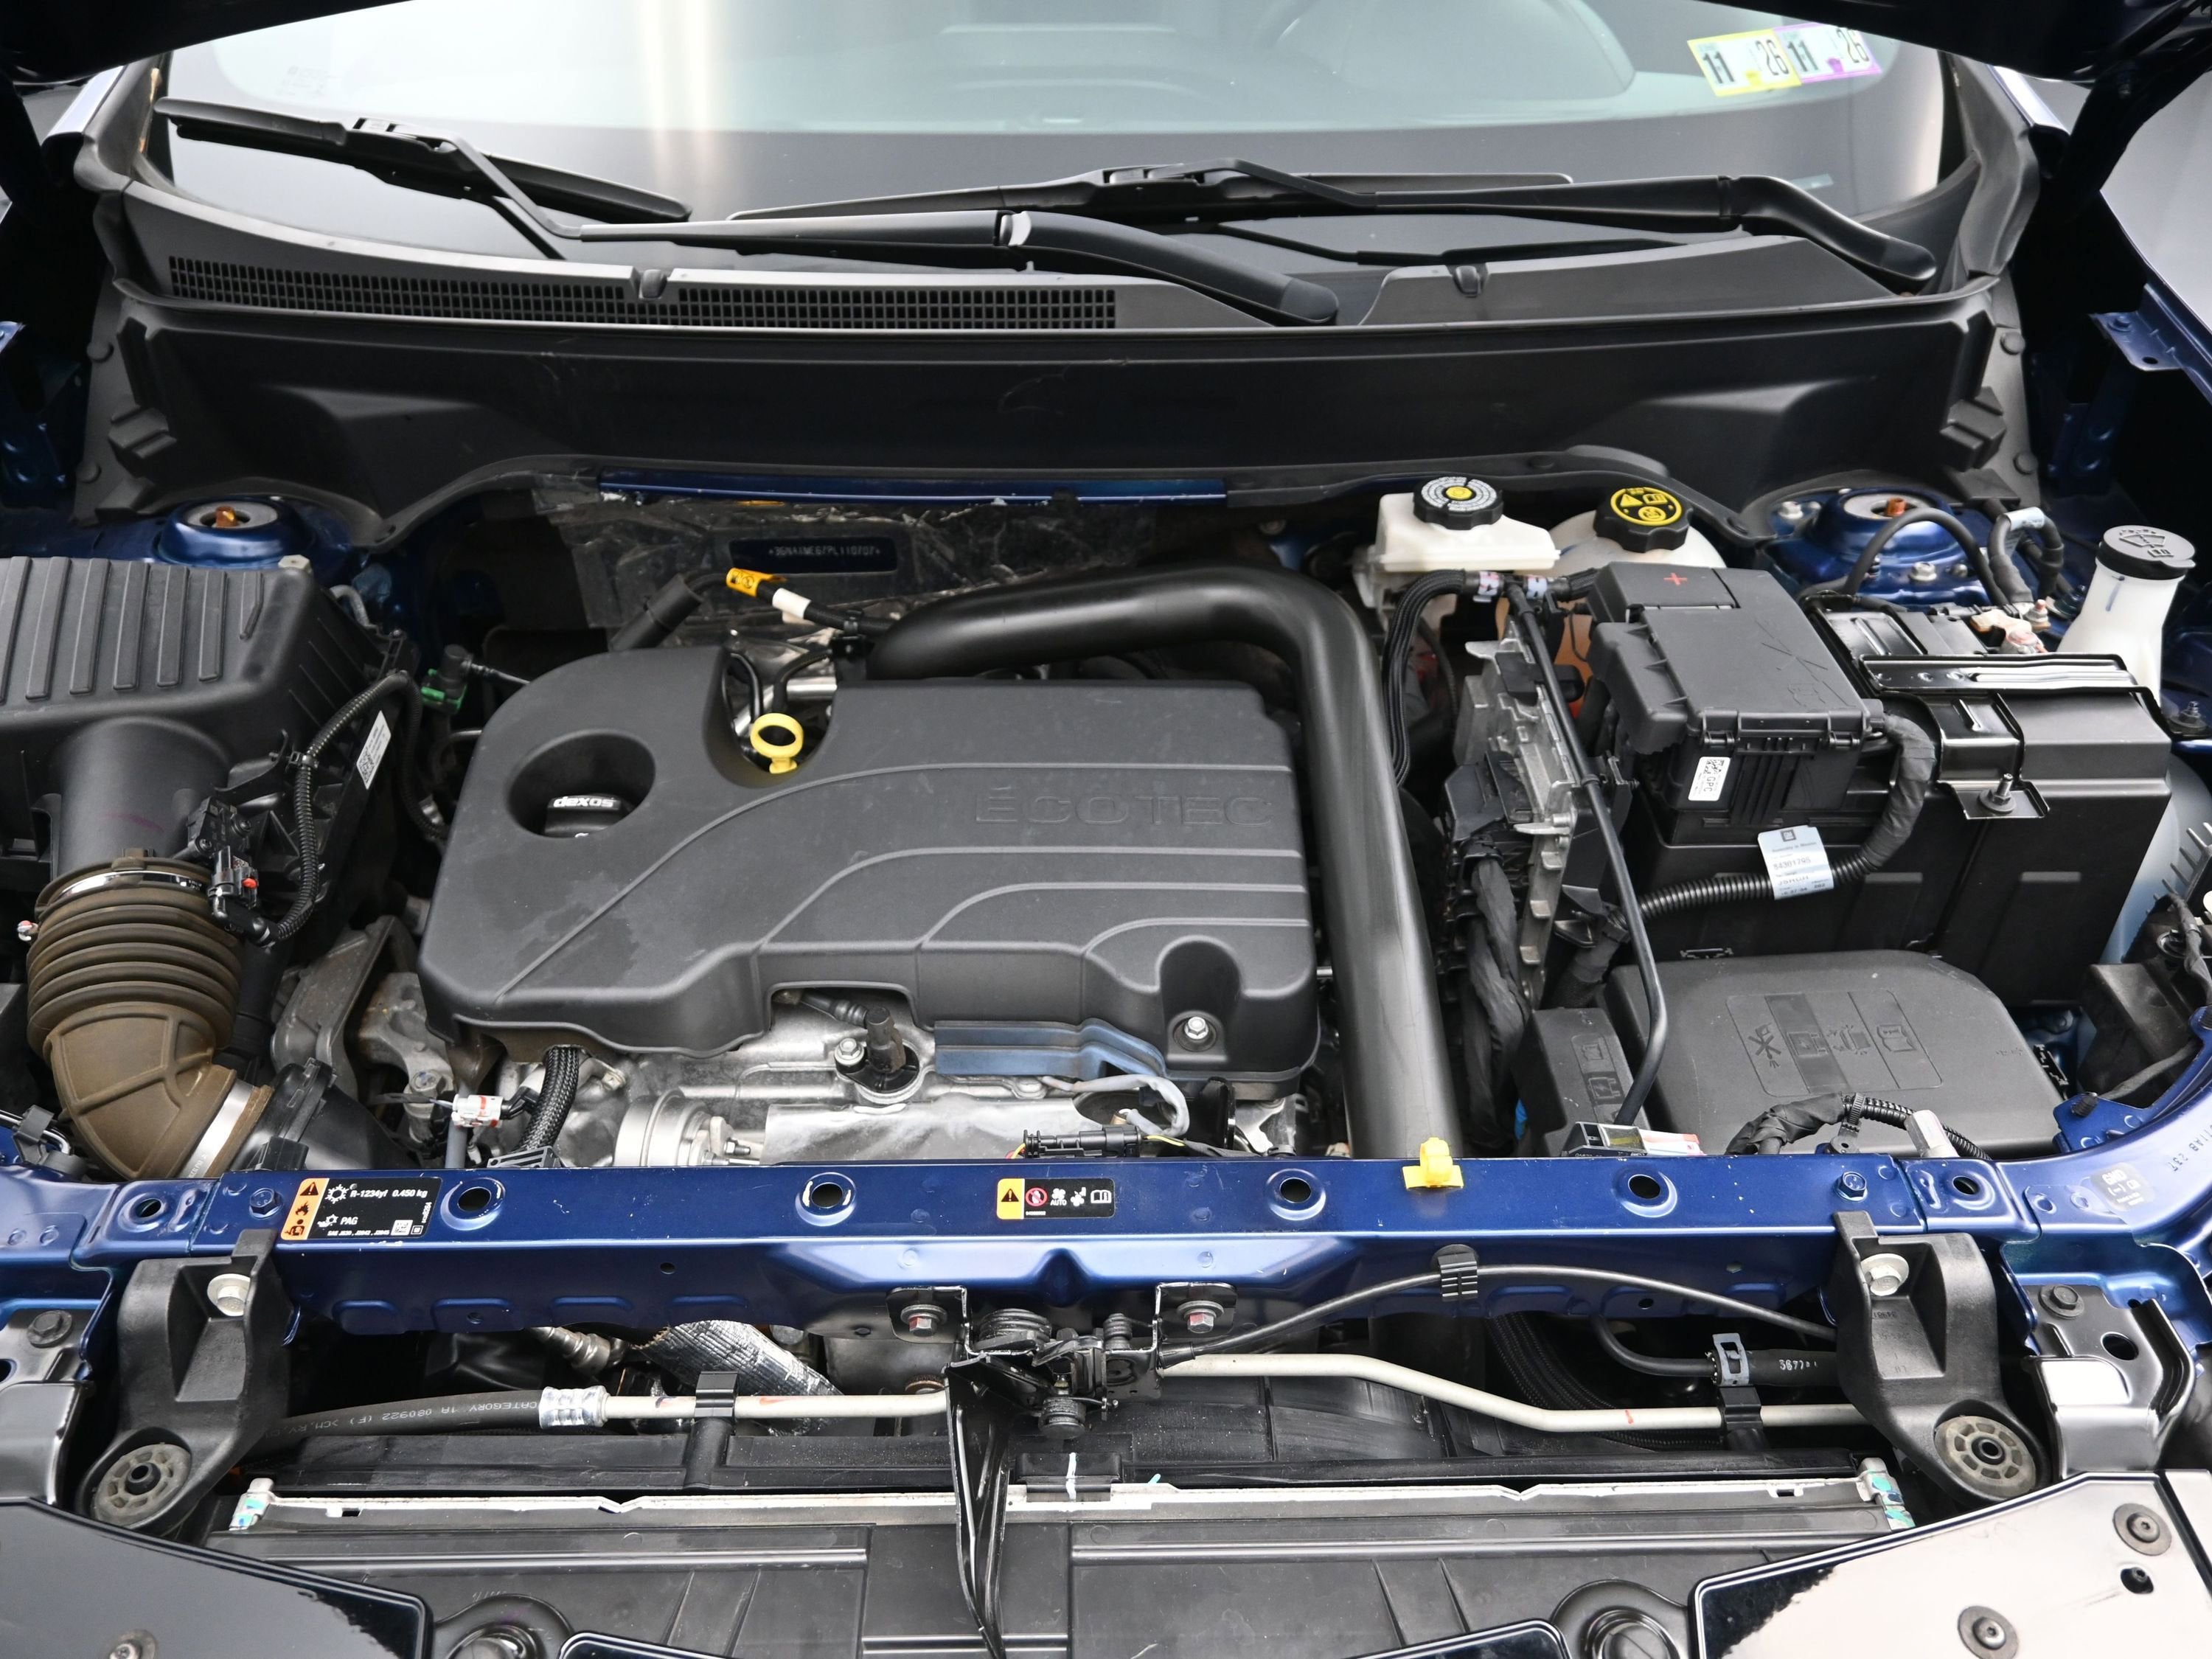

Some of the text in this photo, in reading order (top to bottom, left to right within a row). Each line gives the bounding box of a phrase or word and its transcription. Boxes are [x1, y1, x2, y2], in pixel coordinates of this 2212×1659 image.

[1787, 27, 1870, 72] 11 26
[1703, 39, 1790, 84] 11 26
[553, 796, 615, 808] dexos
[975, 796, 1273, 827] ECOTEC
[349, 1189, 428, 1199] R-1234yf 0.450 kg
[340, 1217, 359, 1225] PAG
[440, 1405, 456, 1414] 1A
[468, 1401, 538, 1413] CATEGORY
[381, 1409, 433, 1421] 080922
